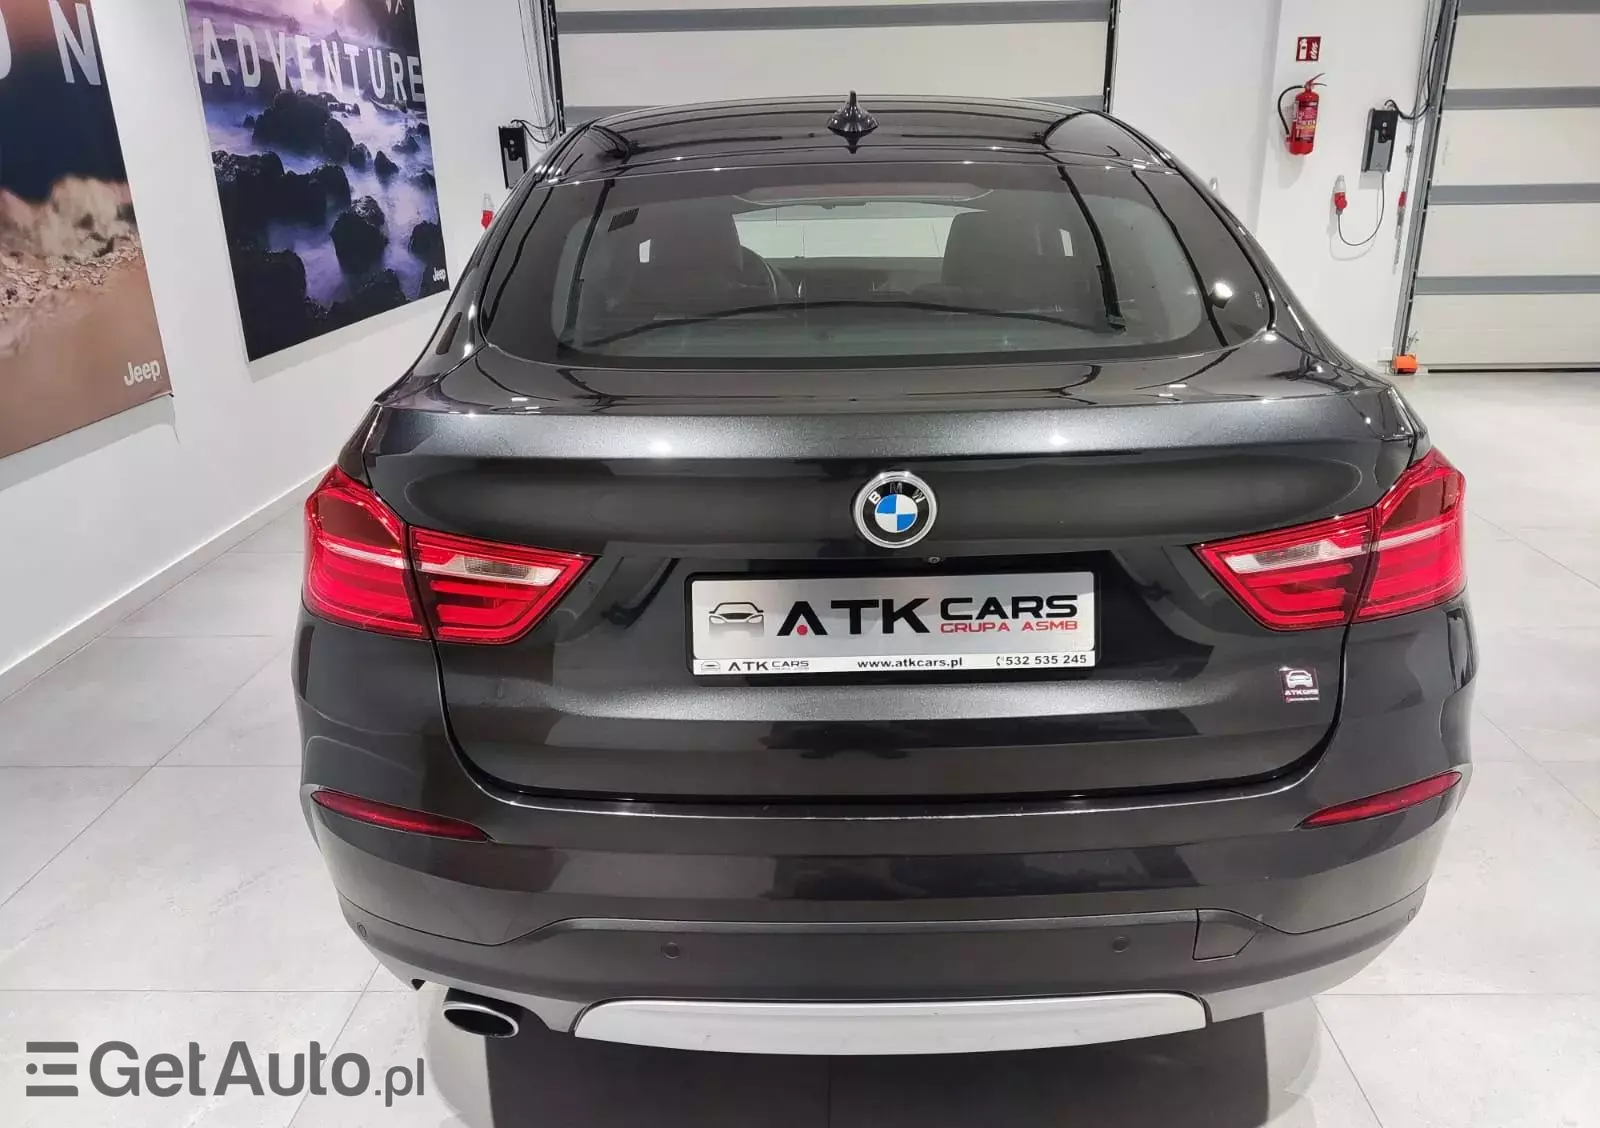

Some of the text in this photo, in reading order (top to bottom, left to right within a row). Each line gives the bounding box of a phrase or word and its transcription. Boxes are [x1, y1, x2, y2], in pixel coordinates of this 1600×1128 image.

[202, 17, 424, 102] ADVENTURE
[433, 267, 446, 281] Jeep
[124, 360, 160, 386] Jeep
[776, 594, 1078, 636] ATK CARS
[940, 620, 1078, 633] GRUPA ASMB
[728, 660, 809, 671] ATK CARS
[857, 657, 963, 668] www.atkcars.pl
[1006, 654, 1088, 666] 532 535 245
